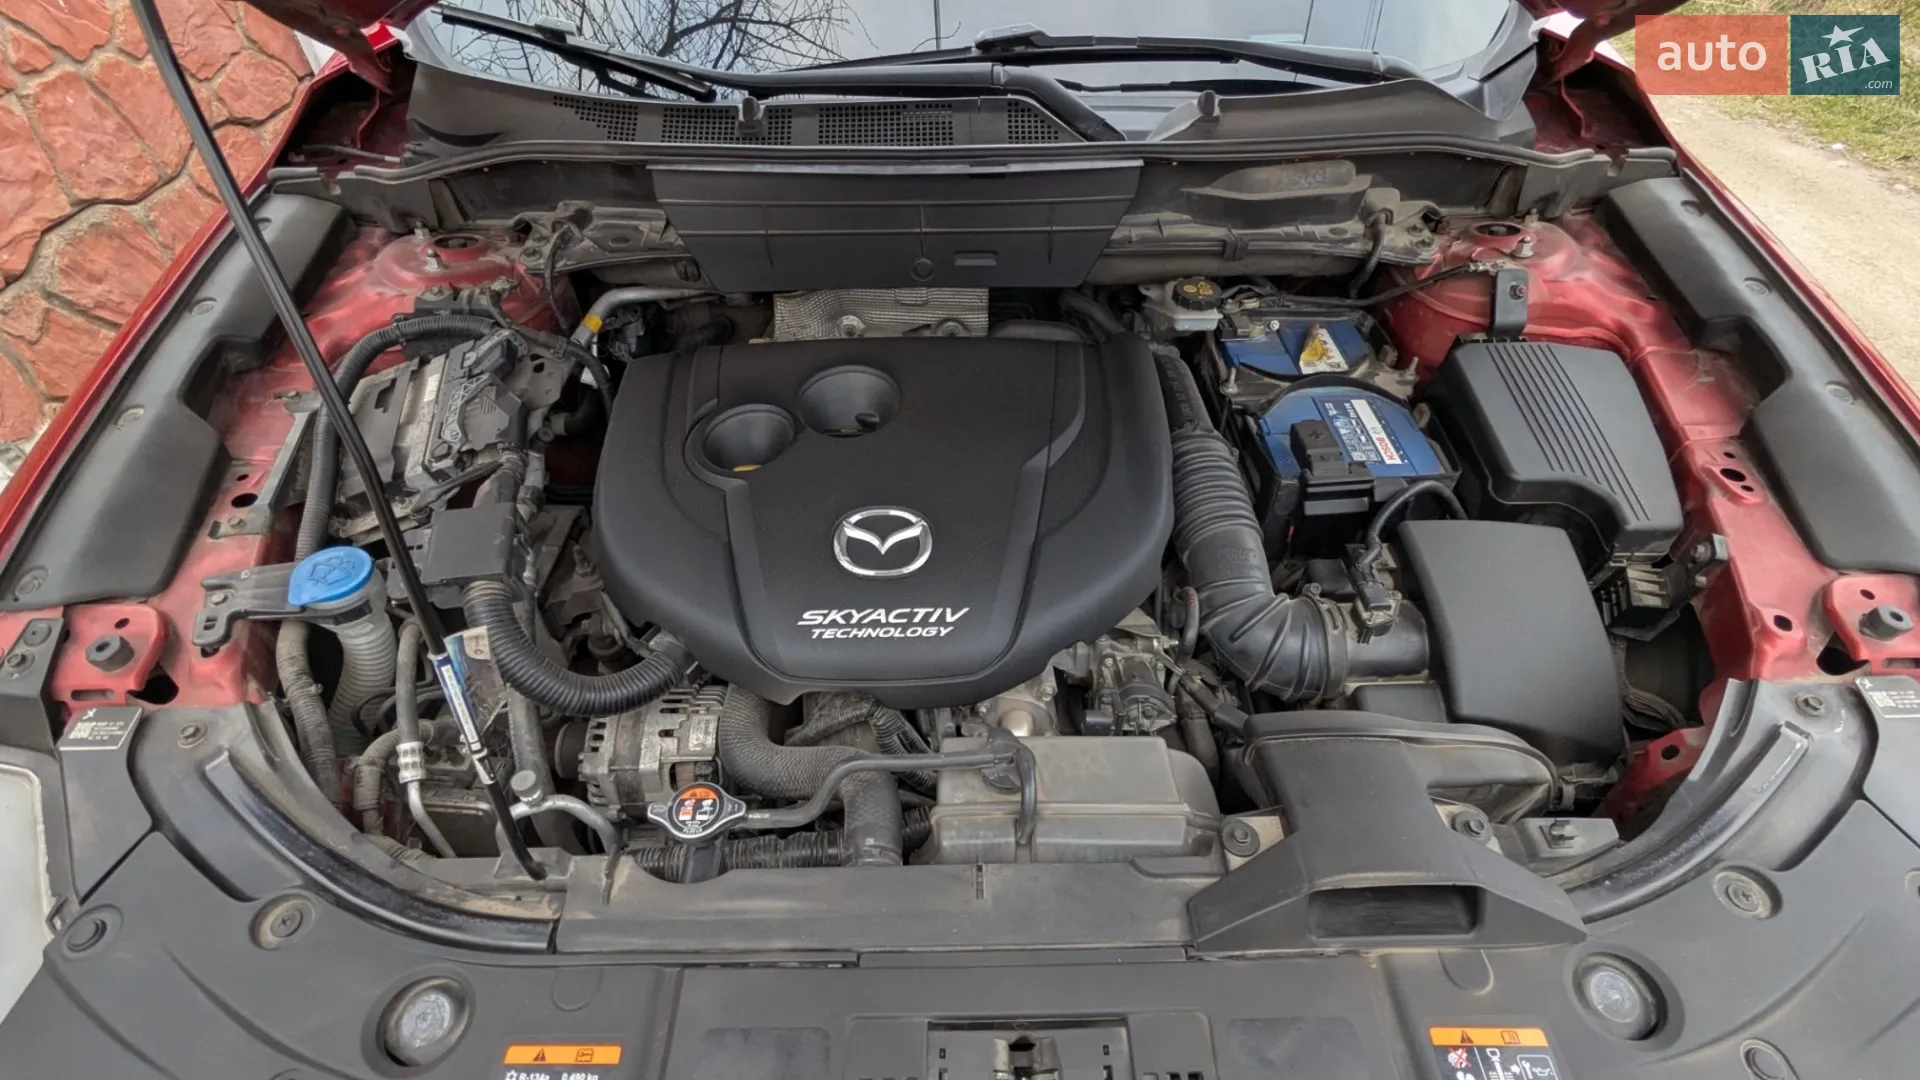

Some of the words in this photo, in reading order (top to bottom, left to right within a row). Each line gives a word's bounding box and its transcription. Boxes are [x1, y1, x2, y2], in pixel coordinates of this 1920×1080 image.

[1376, 437, 1396, 460] BOSCH
[797, 607, 970, 625] SKYACTIV
[811, 627, 954, 639] TECHNOLOGY
